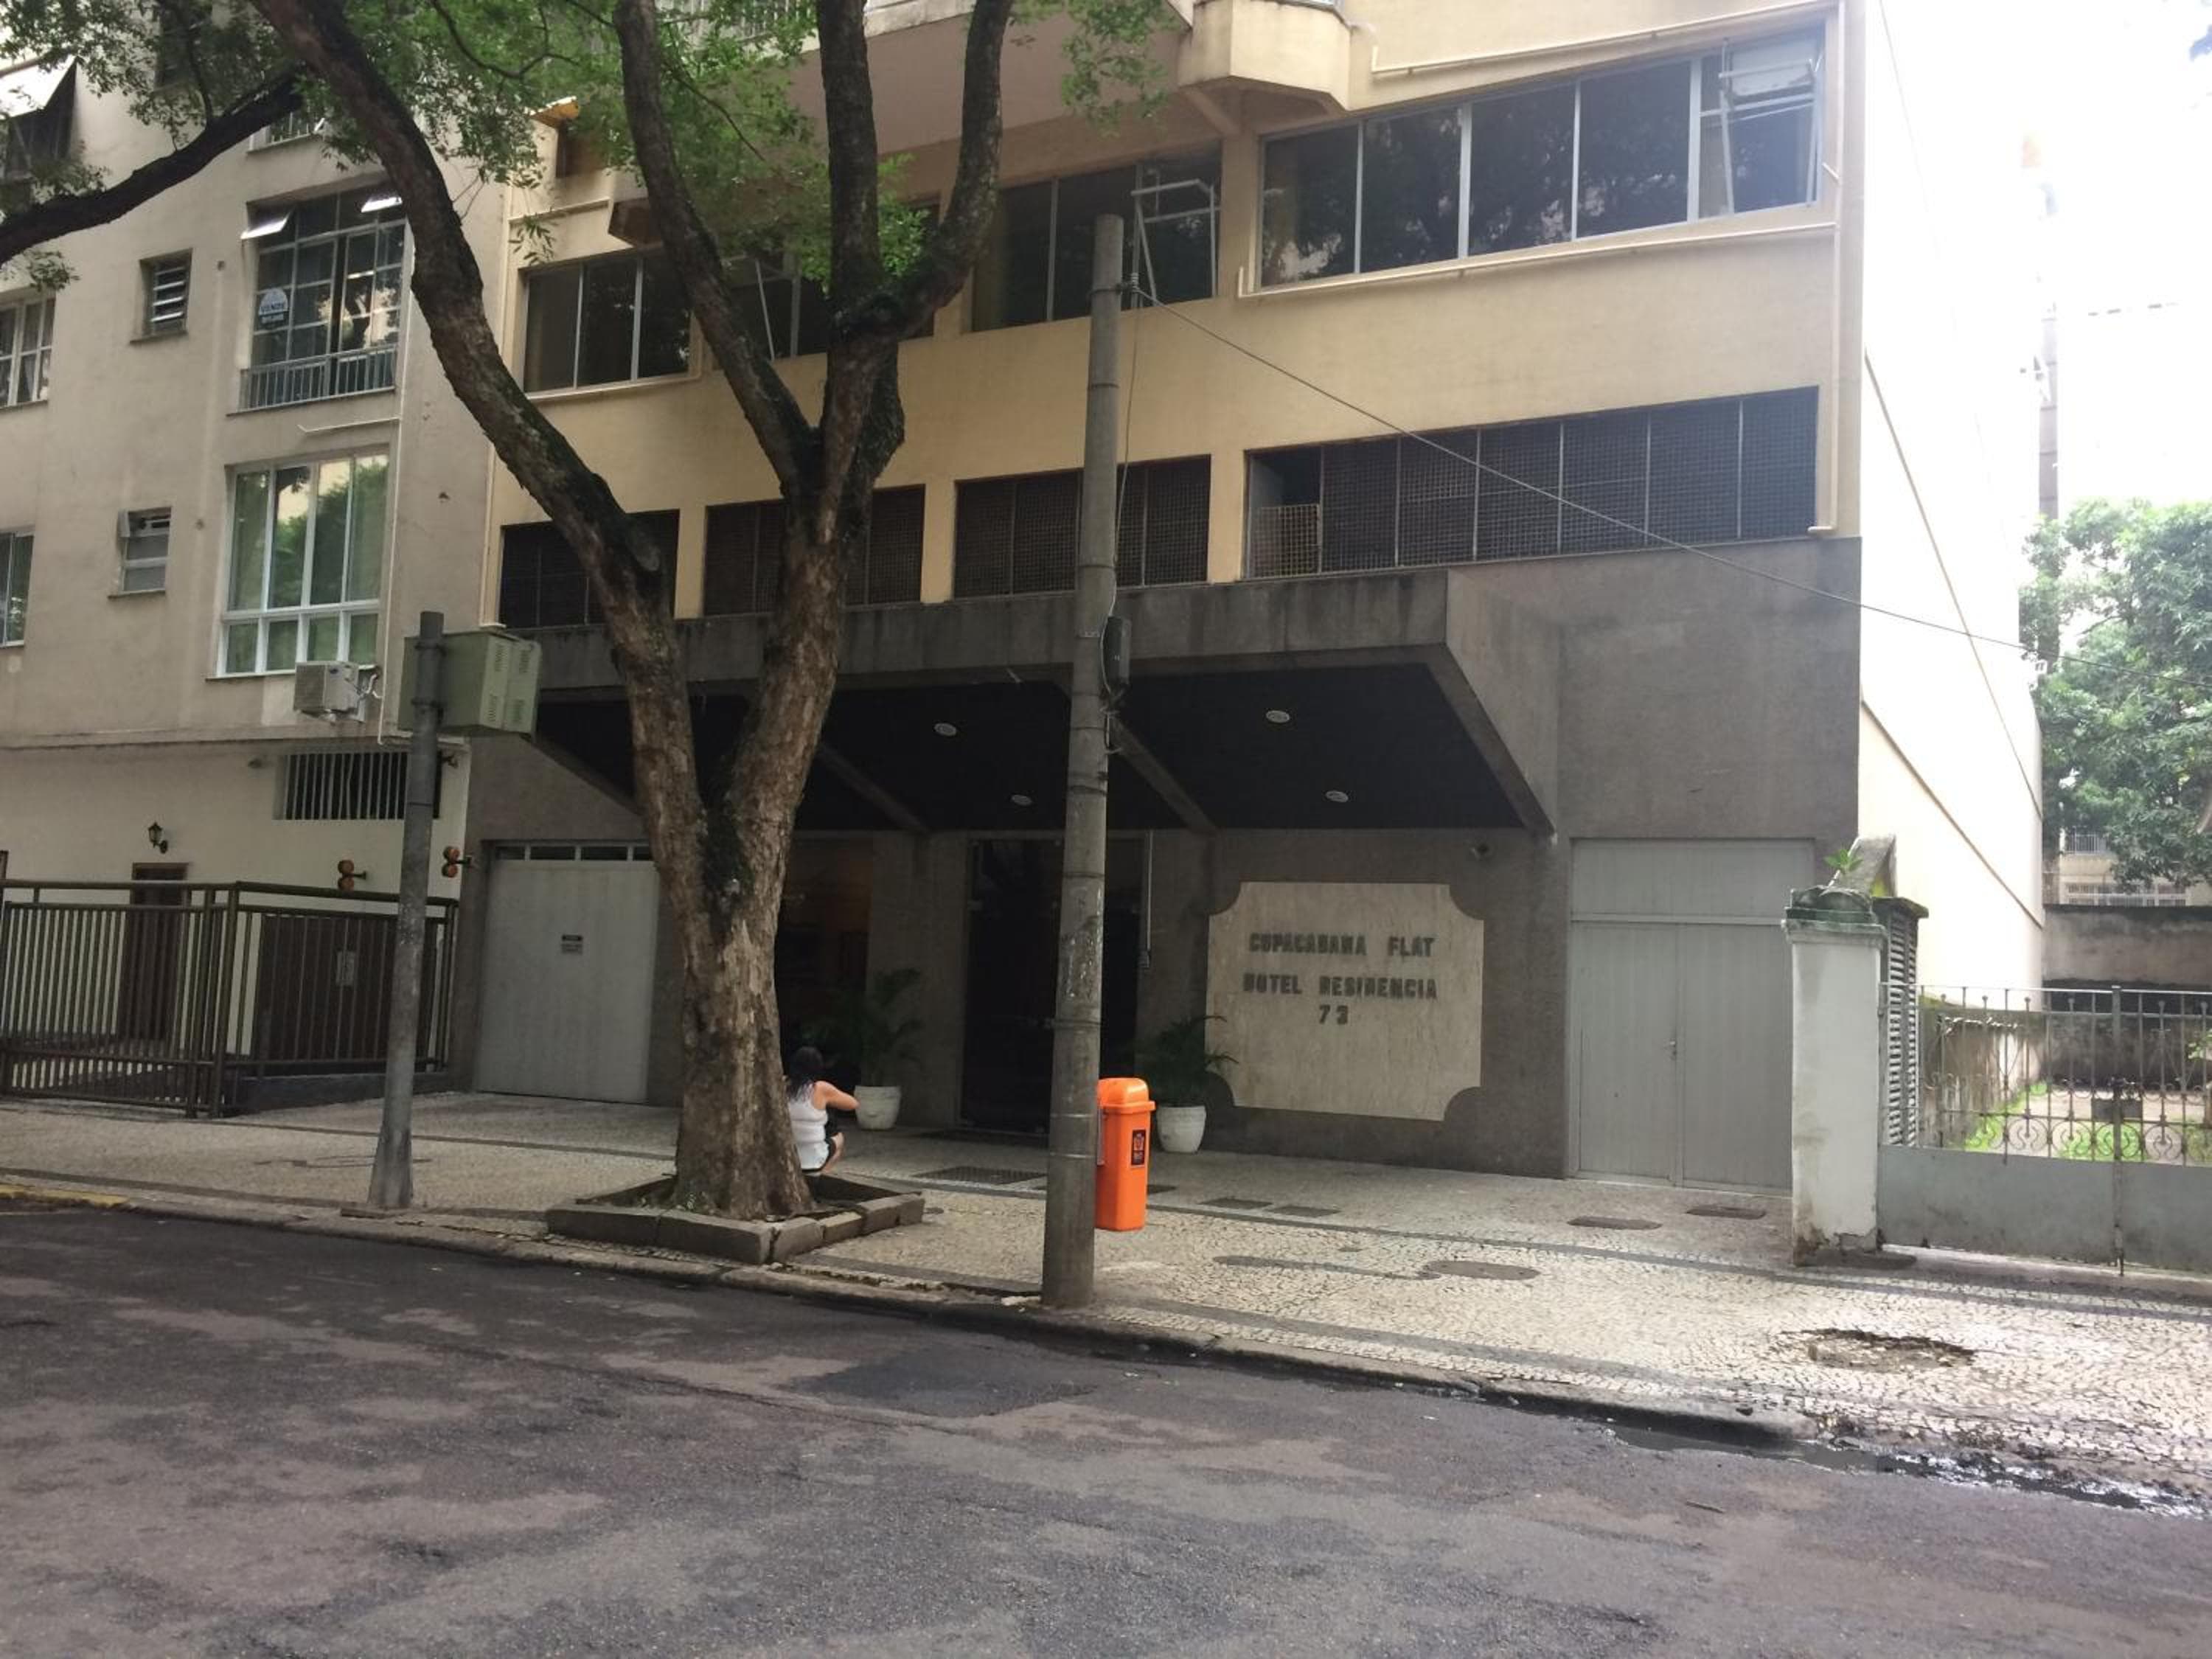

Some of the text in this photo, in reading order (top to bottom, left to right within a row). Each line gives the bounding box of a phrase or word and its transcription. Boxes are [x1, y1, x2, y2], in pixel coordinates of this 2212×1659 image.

[1249, 932, 1436, 957] COPACABANA FLAT
[1242, 973, 1438, 1000] HOTEL RESIDENCIA
